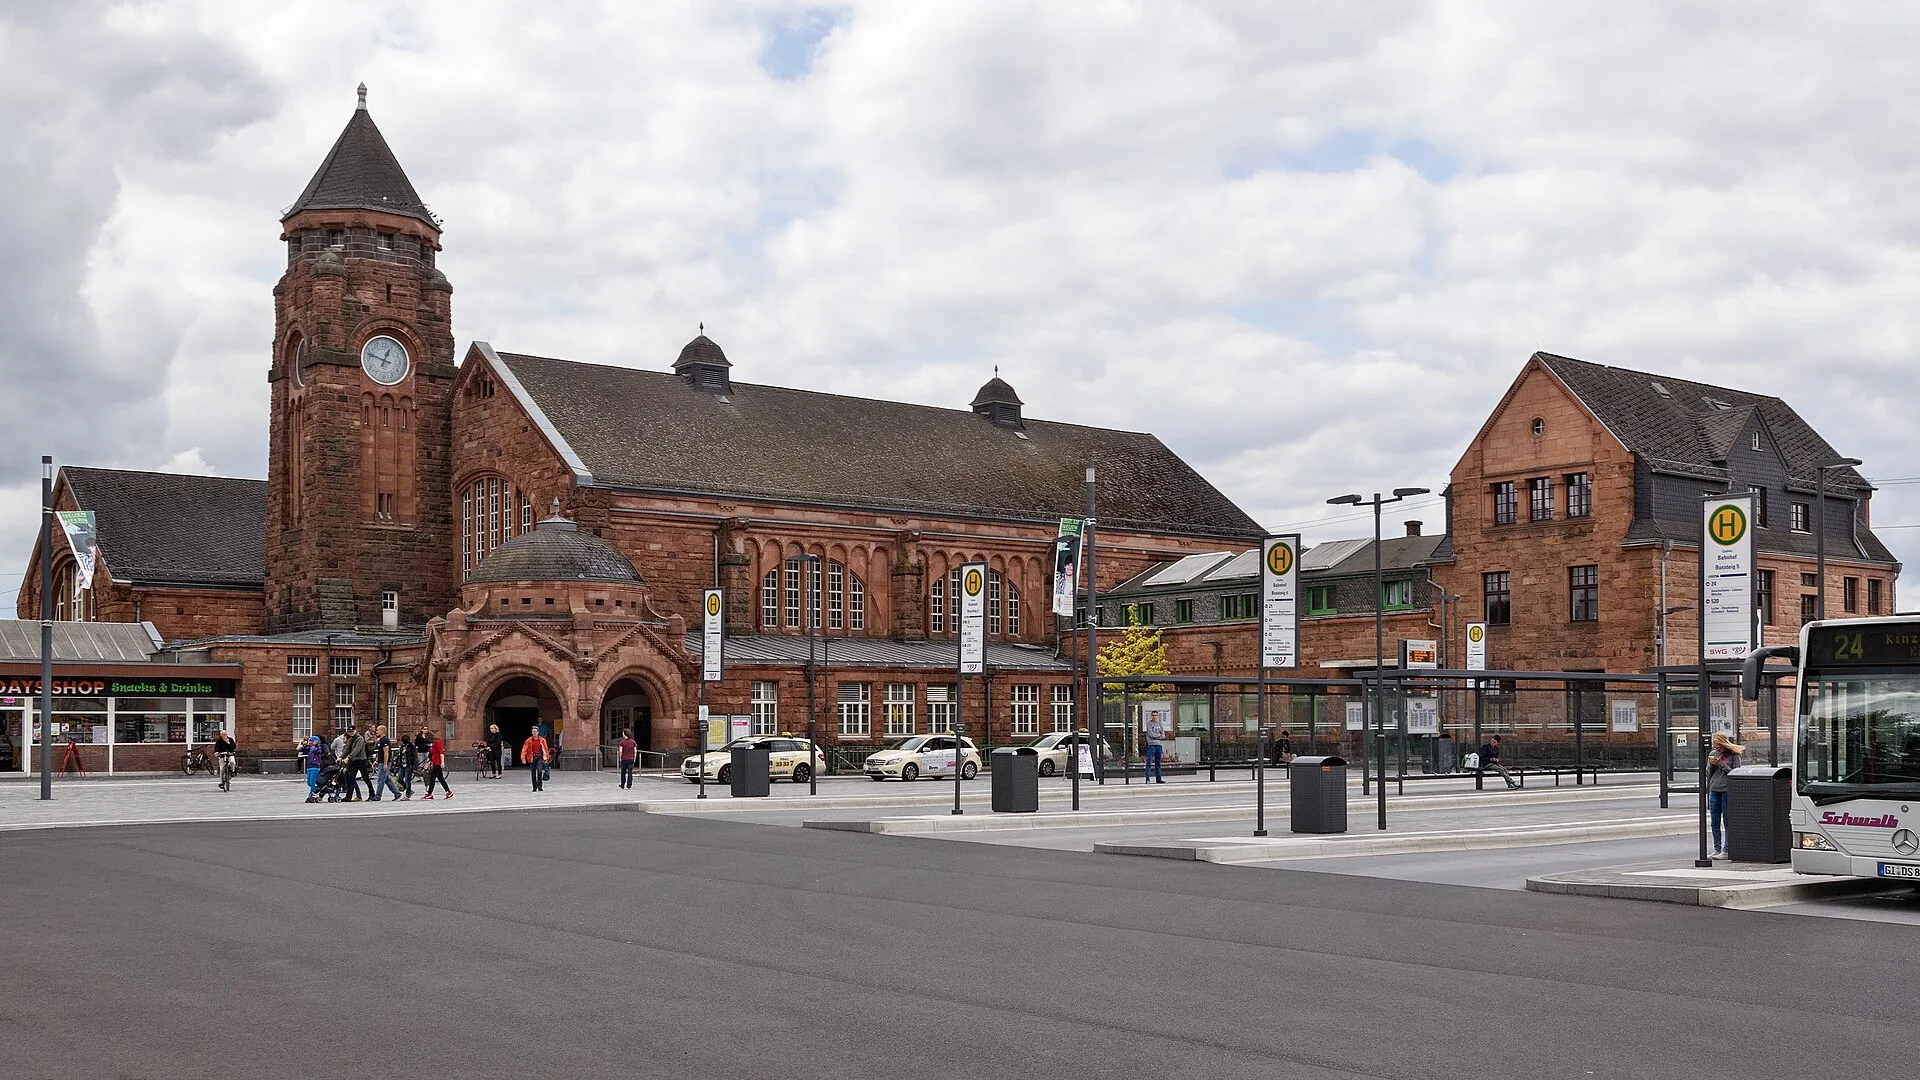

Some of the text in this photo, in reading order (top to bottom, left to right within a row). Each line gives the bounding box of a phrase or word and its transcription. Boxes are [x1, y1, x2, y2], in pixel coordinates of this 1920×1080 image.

[1719, 513, 1735, 537] H
[1274, 550, 1285, 568] H
[970, 575, 977, 590] H
[1834, 633, 1863, 659] 24
[52, 681, 105, 694] SHOP
[111, 683, 212, 693] Snacks & Drinks
[1819, 812, 1898, 828] Schwalb
